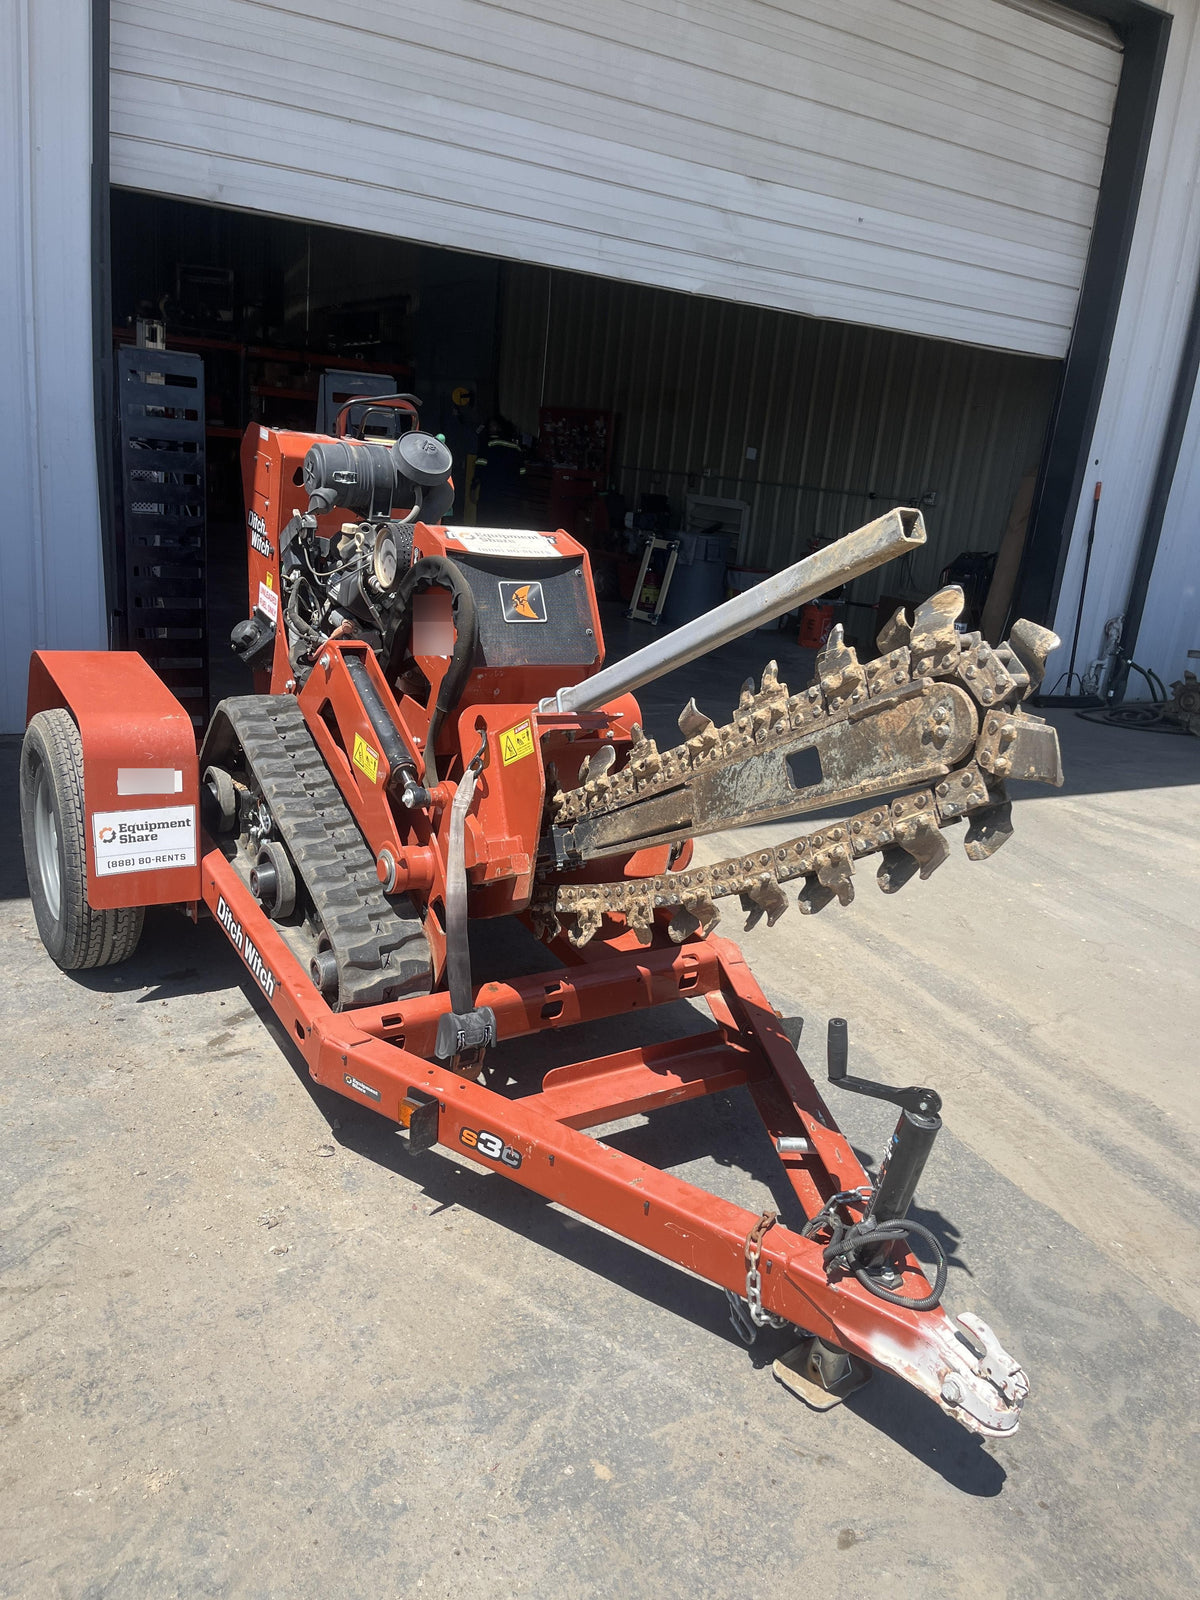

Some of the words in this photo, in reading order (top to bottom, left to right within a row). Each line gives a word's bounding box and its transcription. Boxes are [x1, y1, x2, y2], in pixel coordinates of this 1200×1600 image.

[248, 510, 265, 533] Ditch
[251, 530, 270, 557] Witch
[118, 818, 191, 834] Equipment
[119, 833, 158, 844] Share
[107, 858, 135, 868] (888)
[138, 853, 186, 865] 80-RENTS
[217, 896, 243, 949] Ditch
[244, 935, 275, 998] Witch
[352, 1077, 379, 1096] Equipment
[352, 1083, 366, 1094] Share
